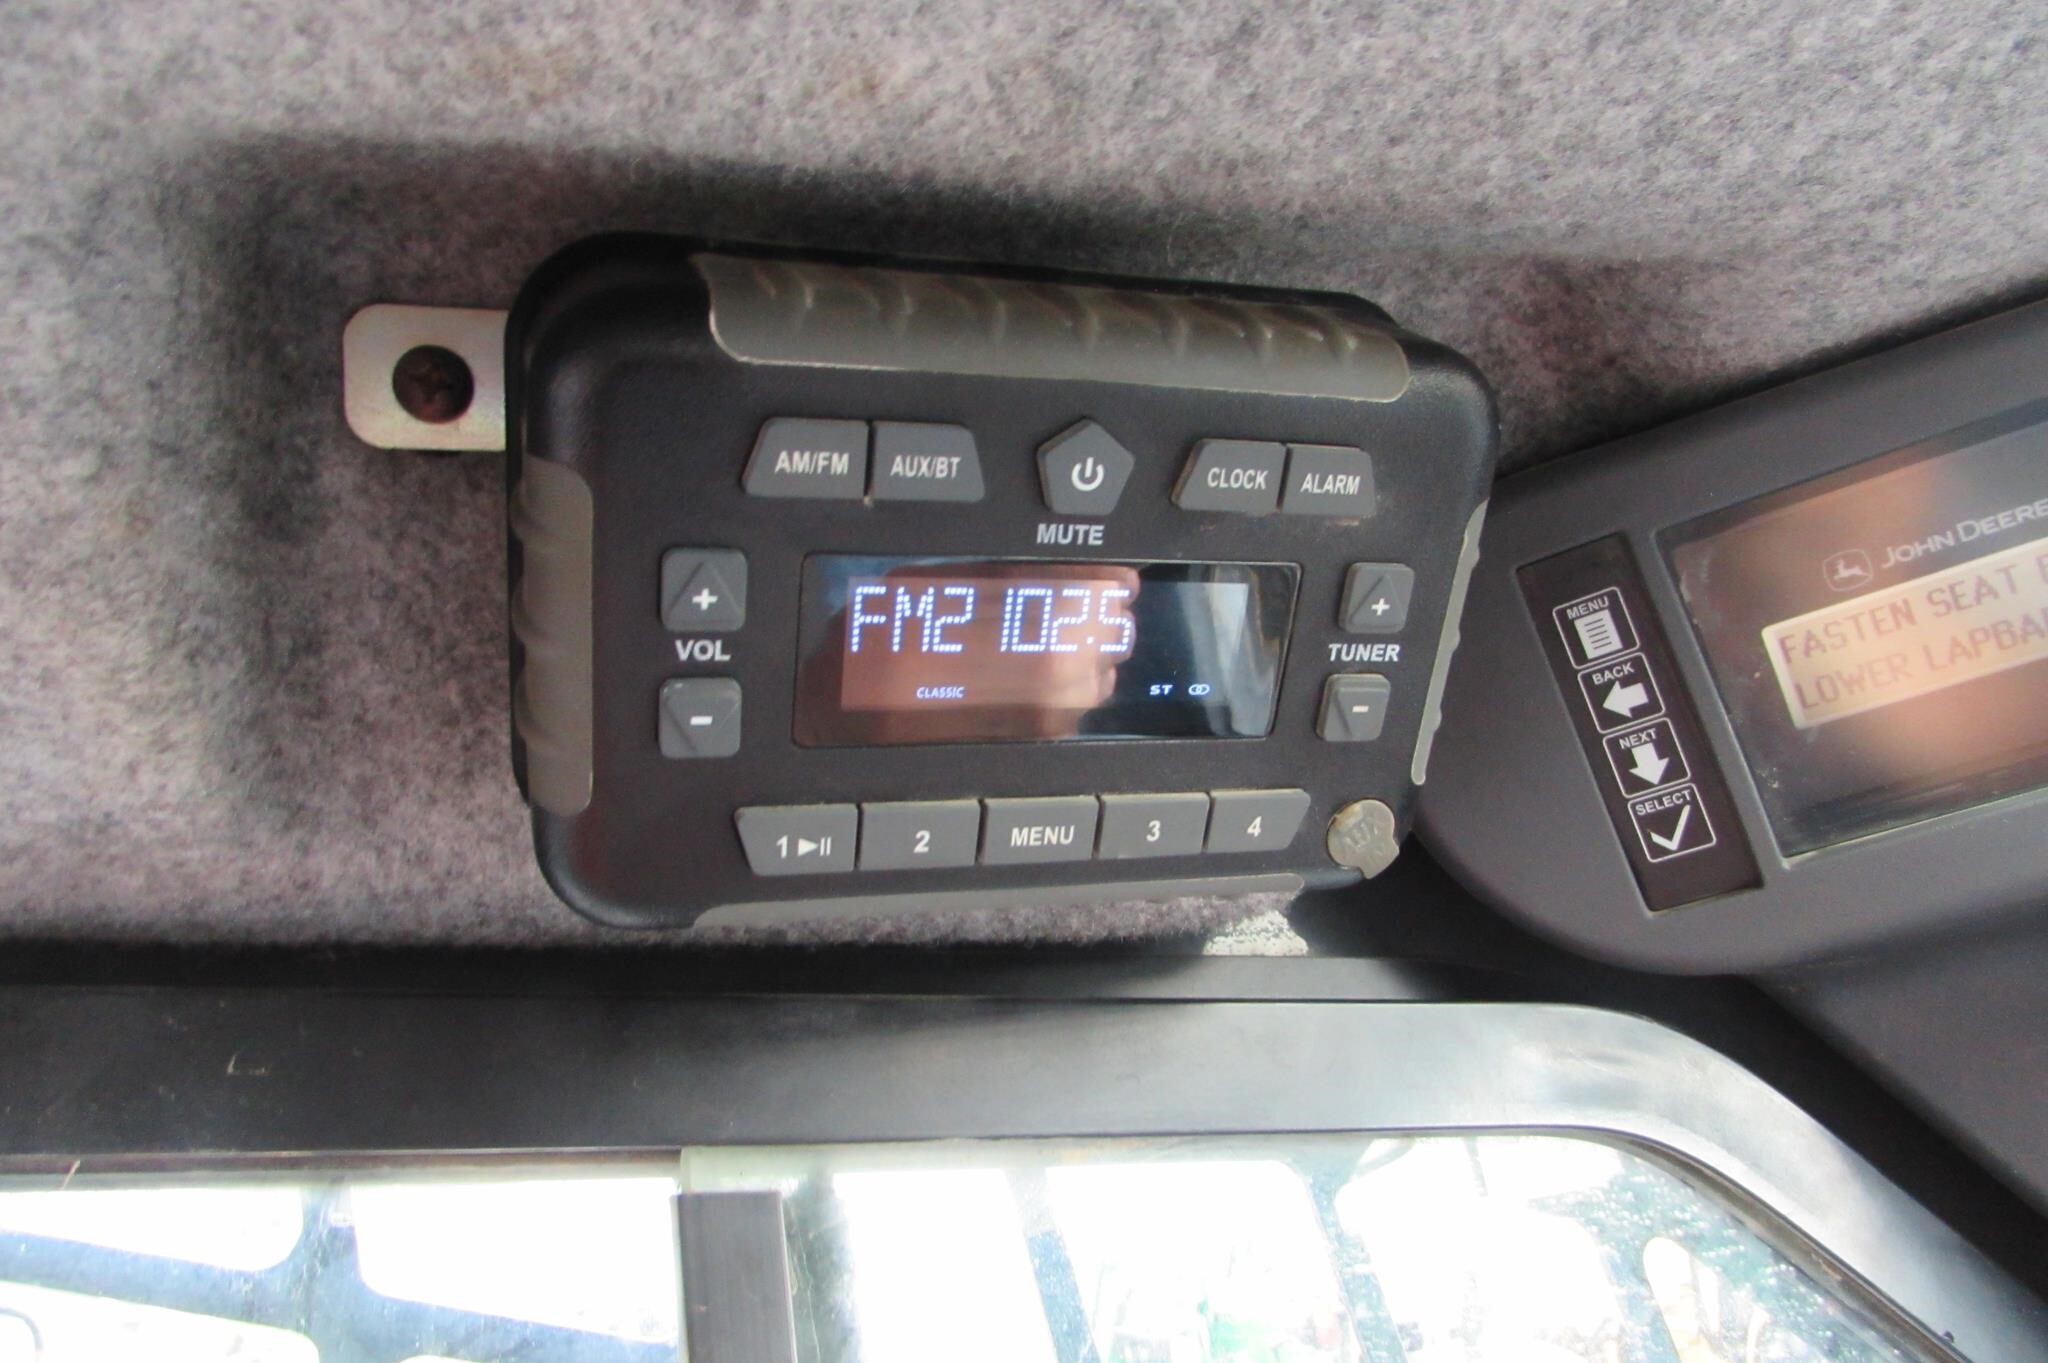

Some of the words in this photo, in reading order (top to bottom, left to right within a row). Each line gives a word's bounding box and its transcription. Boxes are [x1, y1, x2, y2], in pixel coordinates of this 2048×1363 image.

[774, 450, 850, 474] AM/FM
[889, 456, 961, 479] AUX/BT
[1206, 467, 1269, 490] CLOCK
[1300, 472, 1361, 496] ALARM
[1036, 523, 1105, 546] MUTE
[1881, 530, 1955, 570] JOHN
[1956, 497, 2048, 542] DEERE
[850, 585, 975, 652] FM2
[999, 586, 1133, 653] 102.5
[1566, 595, 1610, 620] MENU
[1778, 599, 1917, 665] FASTEN
[1925, 564, 2018, 619] SEAT
[675, 640, 731, 662] VOL
[1328, 643, 1400, 663] TUNER
[1592, 662, 1635, 686] BACK
[1794, 652, 1914, 710] LOWER
[916, 686, 965, 699] CLASSIC
[1149, 684, 1174, 696] ST
[1618, 728, 1658, 750] NEXT
[1635, 789, 1693, 816] SELECT
[1010, 825, 1076, 847] MENU
[1146, 820, 1161, 842] 3
[1246, 815, 1262, 837] 4
[776, 835, 788, 858] 1
[913, 830, 931, 853] 2
